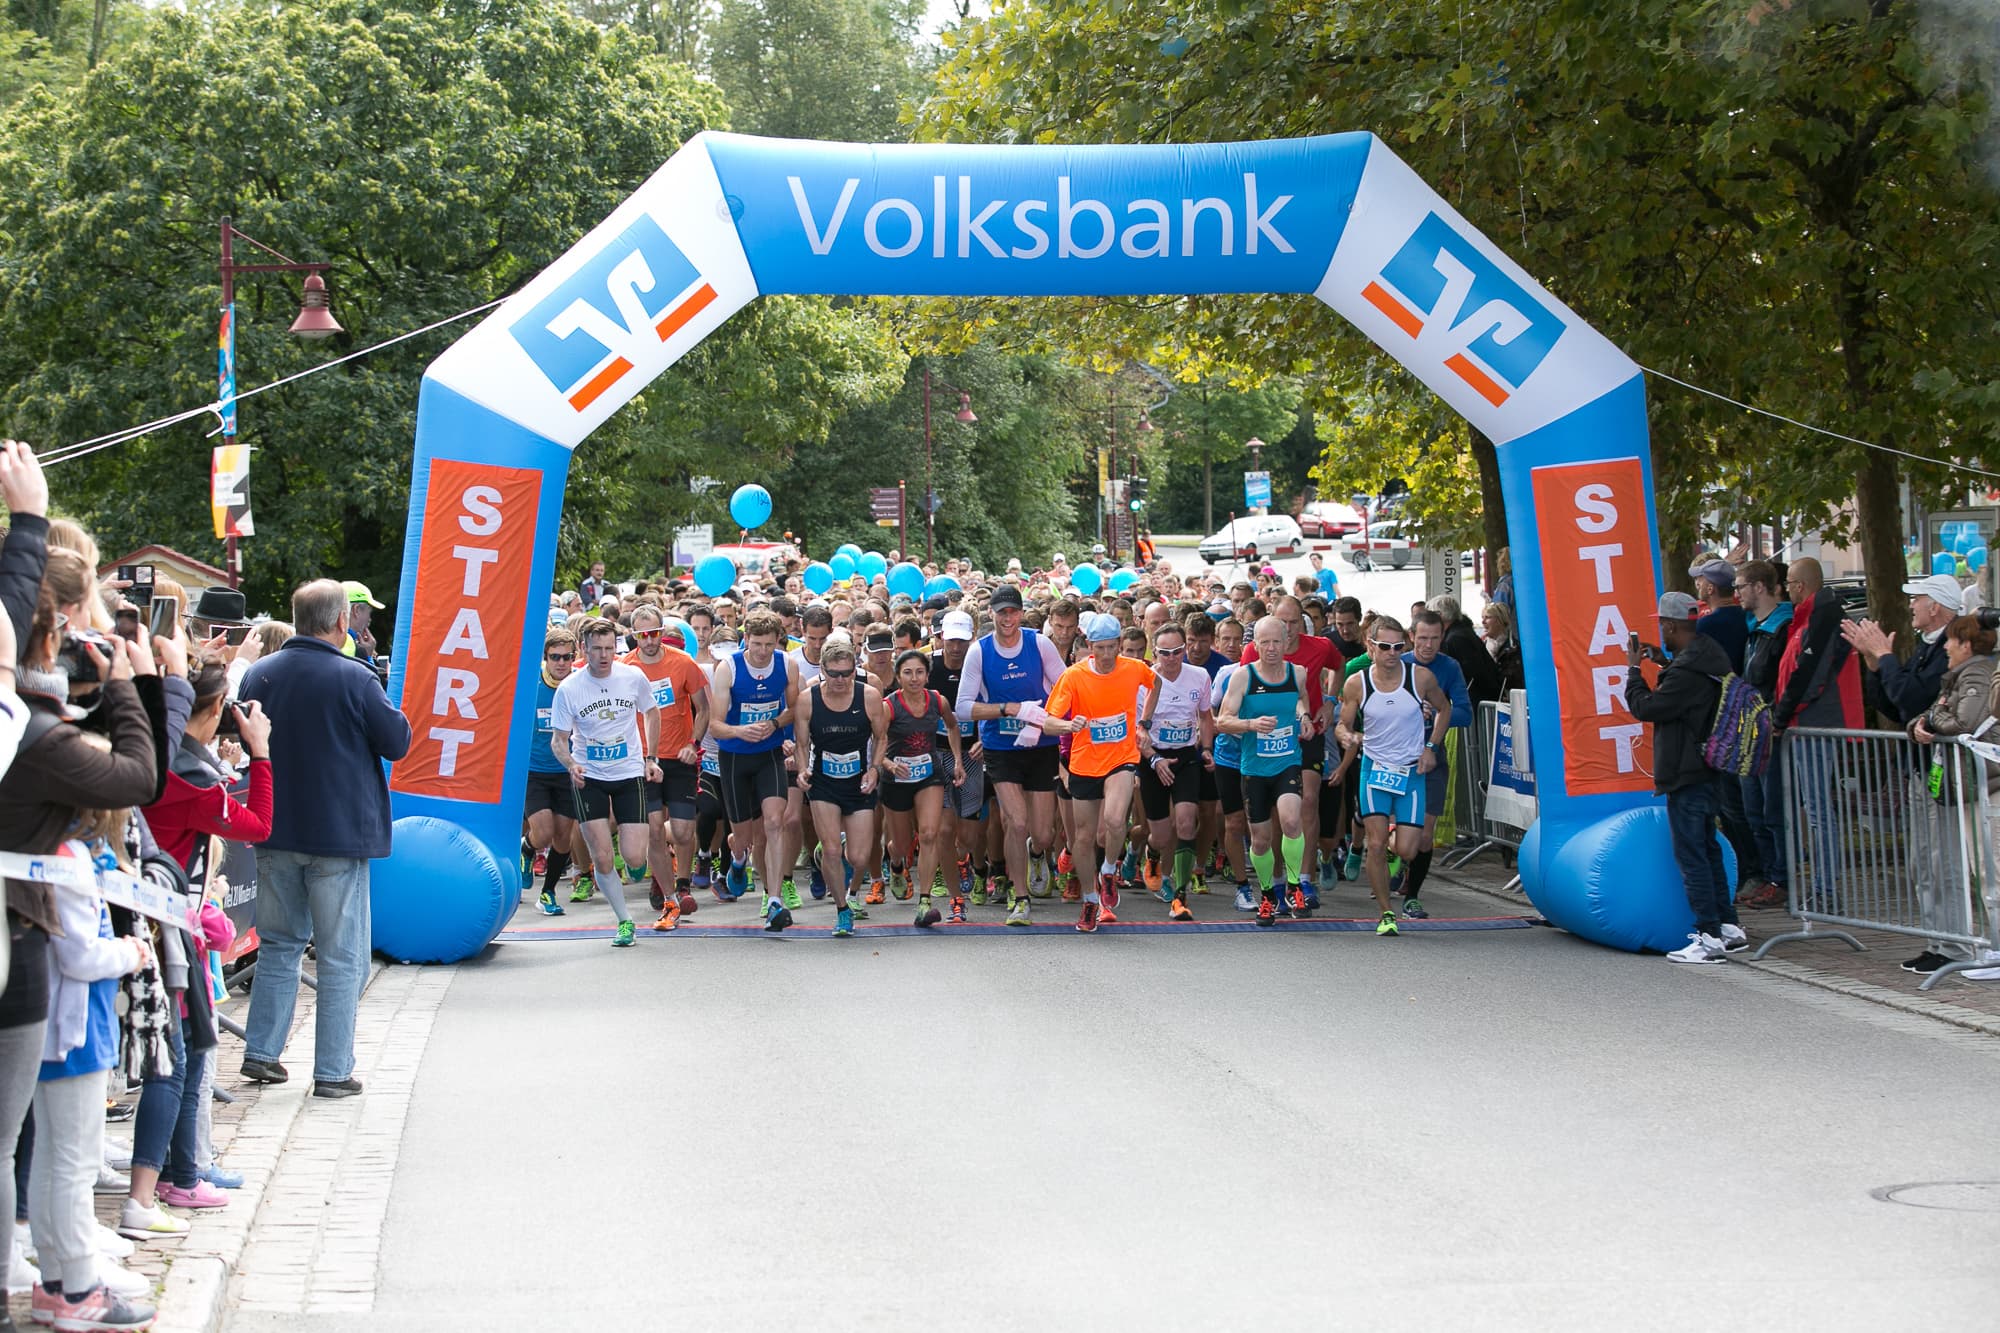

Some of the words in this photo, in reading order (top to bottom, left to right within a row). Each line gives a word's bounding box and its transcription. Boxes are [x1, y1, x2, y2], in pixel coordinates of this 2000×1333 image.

[787, 173, 1297, 258] Volksbank
[428, 485, 503, 777] START
[1574, 483, 1644, 774] START
[652, 690, 667, 703] 75
[580, 698, 612, 718] GEORGIA
[1097, 725, 1124, 739] 1309
[594, 745, 621, 758] 1177
[1263, 738, 1288, 751] 1205
[829, 762, 855, 775] 1141
[909, 765, 927, 778] 564
[1375, 772, 1402, 787] 1257
